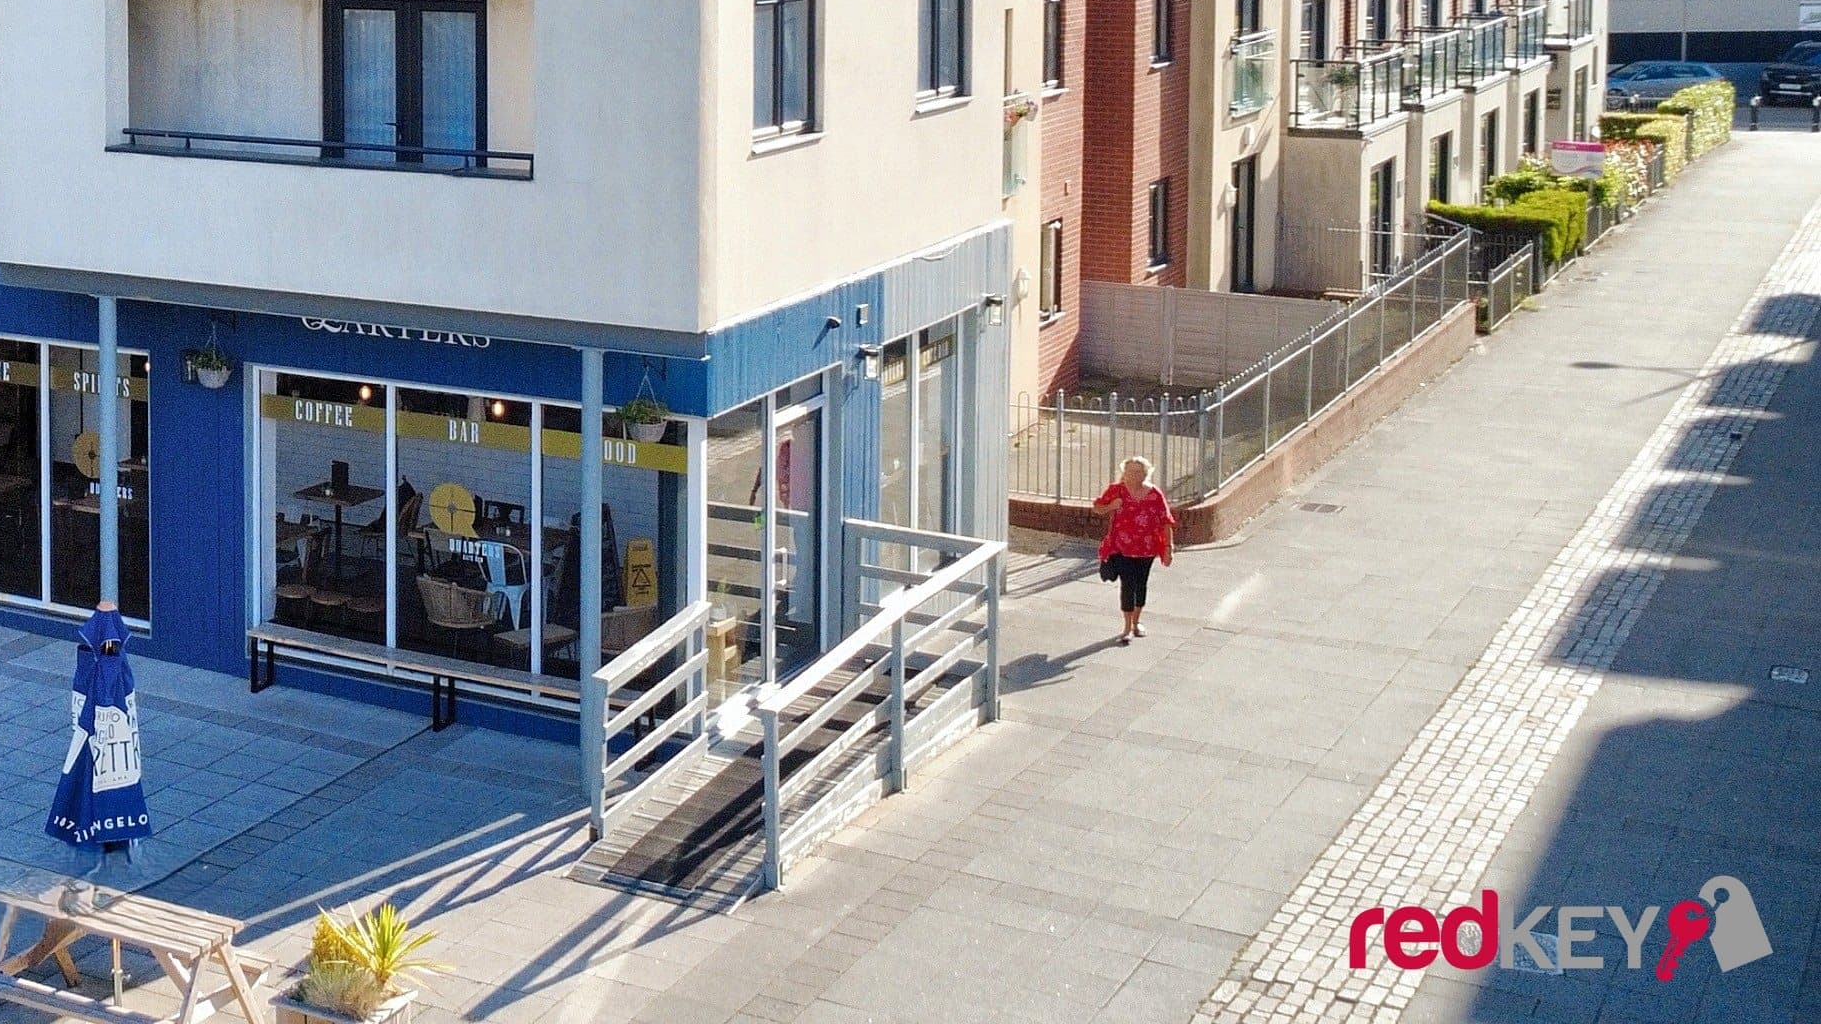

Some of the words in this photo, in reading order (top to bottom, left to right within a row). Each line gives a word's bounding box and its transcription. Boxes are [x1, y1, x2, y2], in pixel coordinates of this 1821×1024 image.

[73, 371, 130, 397] SPITS
[294, 398, 354, 428] COFFEE
[448, 418, 480, 444] BAR
[603, 439, 637, 465] OOD
